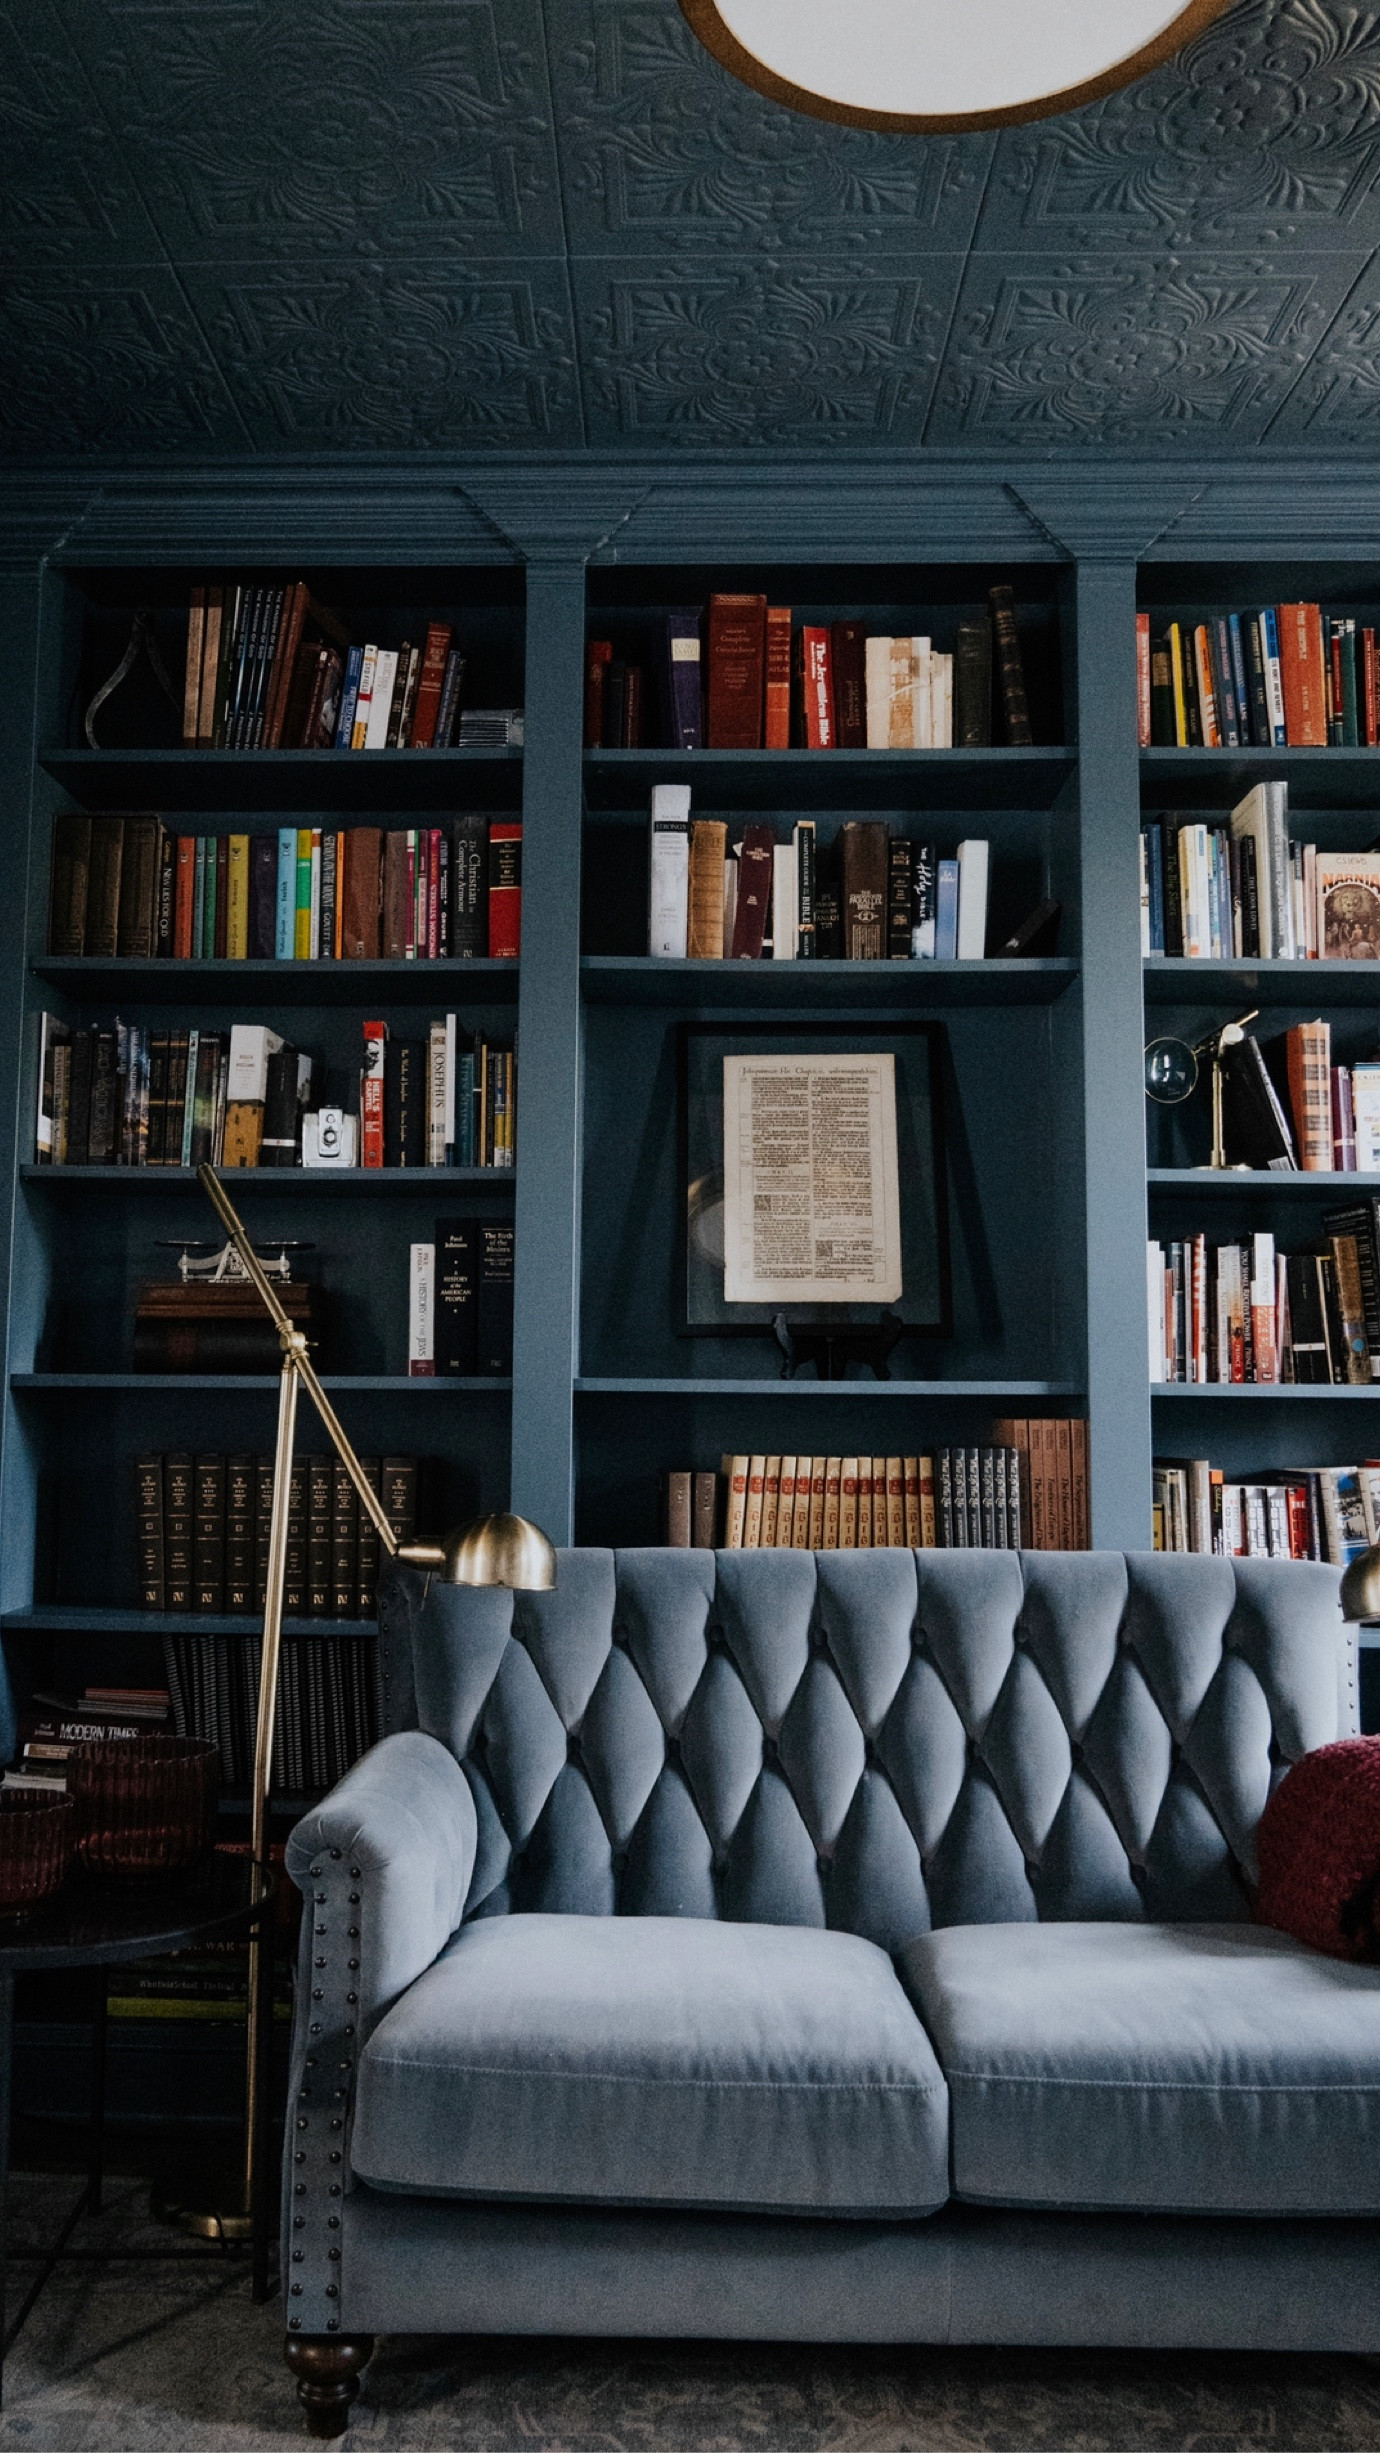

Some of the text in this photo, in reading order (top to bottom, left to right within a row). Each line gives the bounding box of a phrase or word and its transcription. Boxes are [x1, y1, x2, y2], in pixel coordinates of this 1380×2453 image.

[816, 642, 830, 745] The Jerusalem Bible
[323, 835, 335, 860] SERMON
[469, 840, 477, 852] The
[323, 872, 334, 884] THE
[455, 840, 467, 913] Complete Armour
[468, 853, 481, 904] Christian
[912, 862, 932, 895] Holy
[322, 885, 334, 907] MOUNT
[802, 896, 810, 923] BIBLE
[434, 1052, 445, 1108] JOSEPHUS
[419, 1282, 427, 1314] HISTORY
[417, 1337, 427, 1357] JEWS
[1034, 1492, 1042, 1532] Enlightened
[1048, 1517, 1056, 1540] Europe
[59, 1723, 139, 1741] MODERN TIMES
